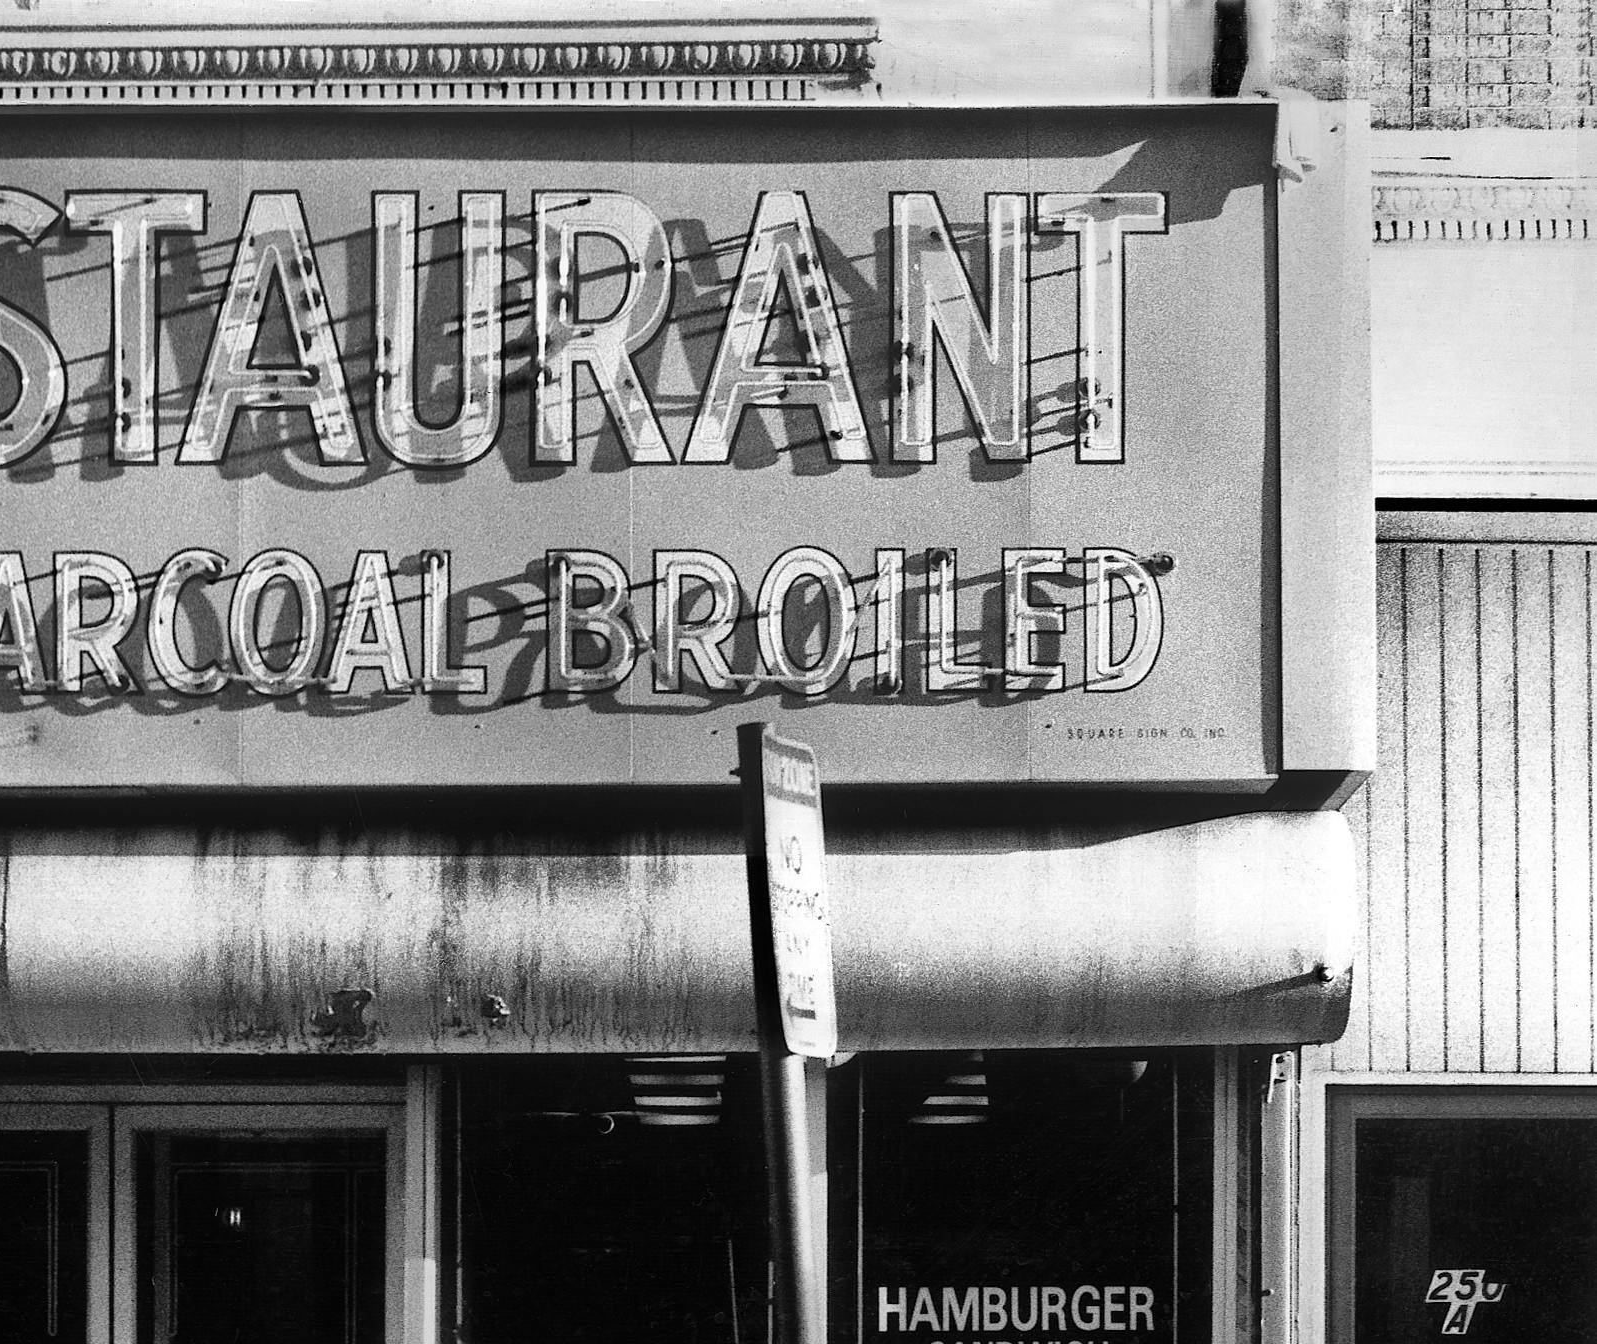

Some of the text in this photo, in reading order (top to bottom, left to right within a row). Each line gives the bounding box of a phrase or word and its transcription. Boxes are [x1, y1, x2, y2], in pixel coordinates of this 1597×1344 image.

[547, 545, 1167, 697] BROILED
[878, 1285, 1154, 1332] HAMBURGER
[1444, 1304, 1469, 1333] A
